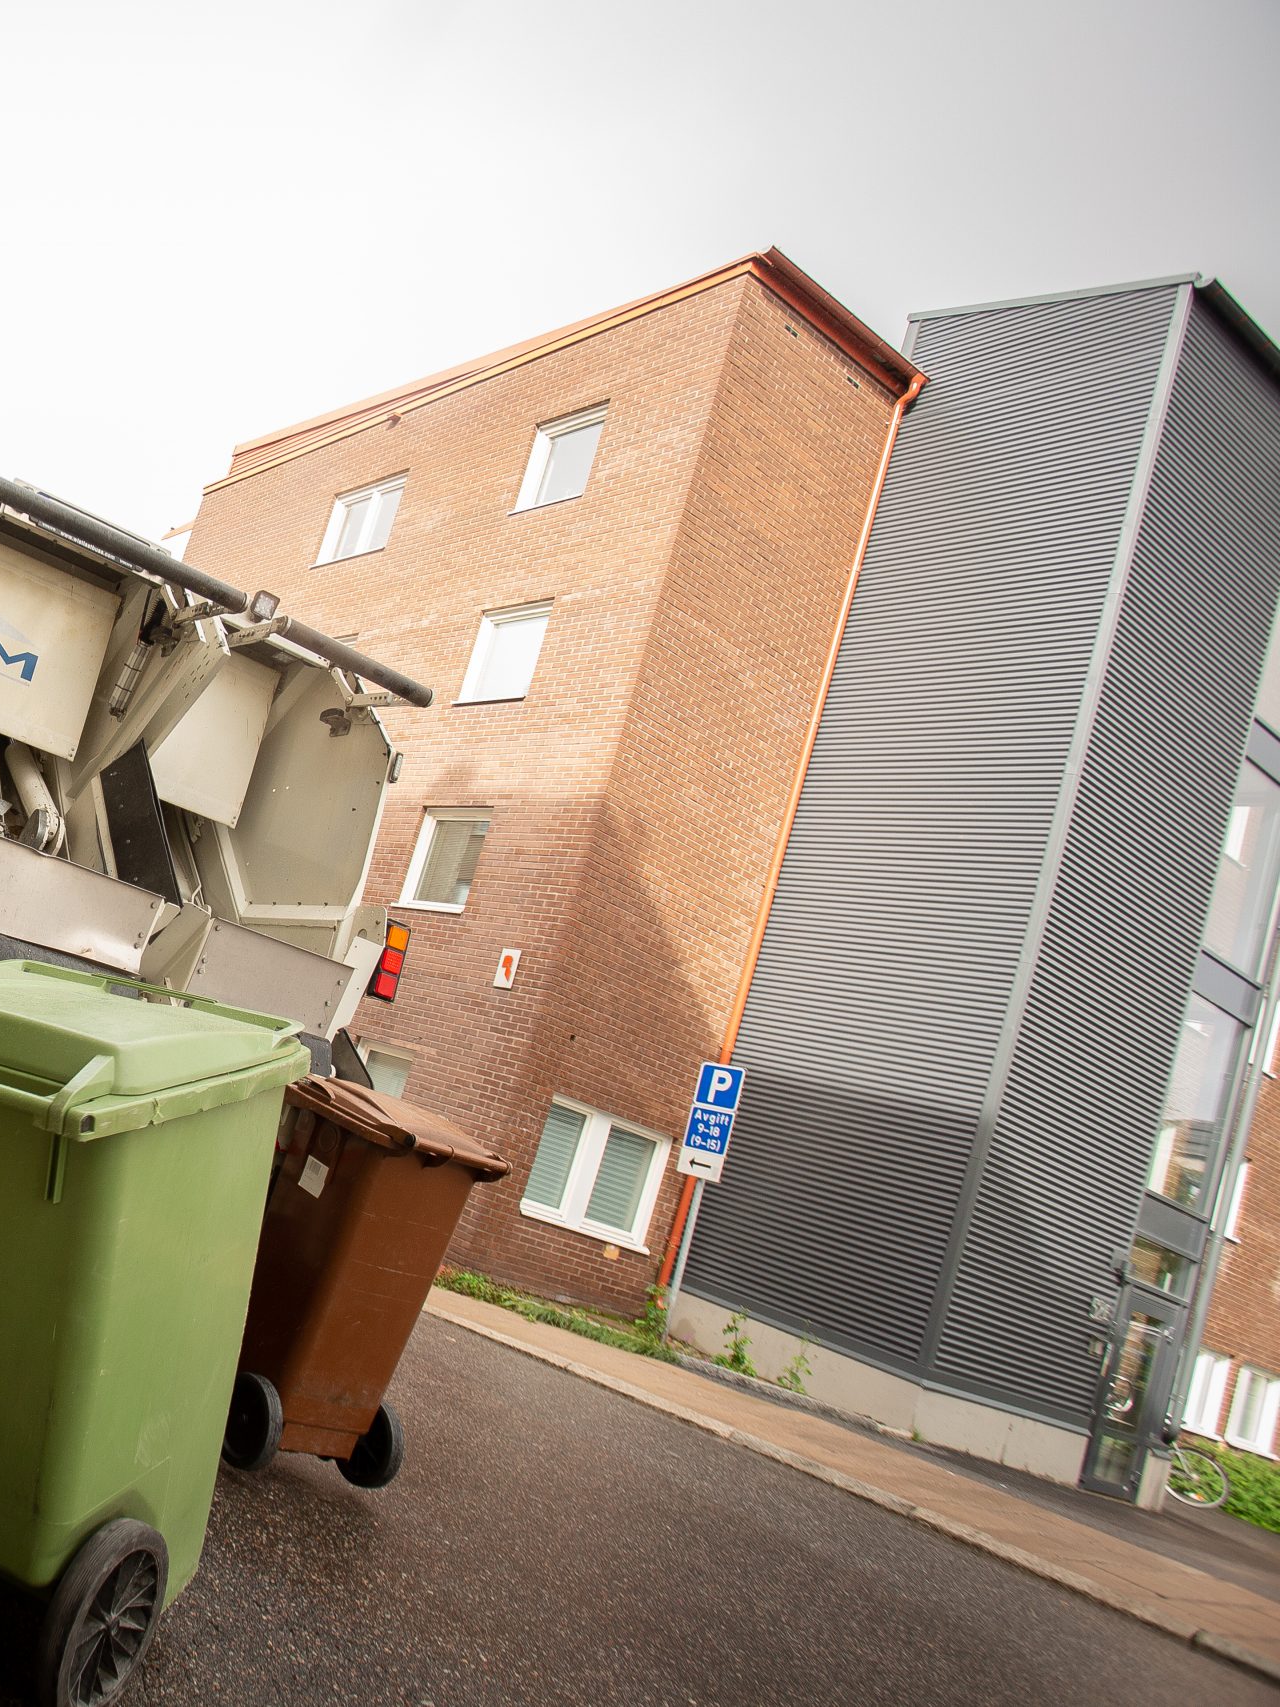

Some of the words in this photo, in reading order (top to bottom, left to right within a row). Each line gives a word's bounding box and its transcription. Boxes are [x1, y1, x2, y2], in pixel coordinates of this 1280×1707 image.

[706, 1069, 733, 1103] P
[694, 1109, 729, 1126] Avgift
[697, 1122, 720, 1138] 9-18
[690, 1133, 721, 1153] (9-15)
